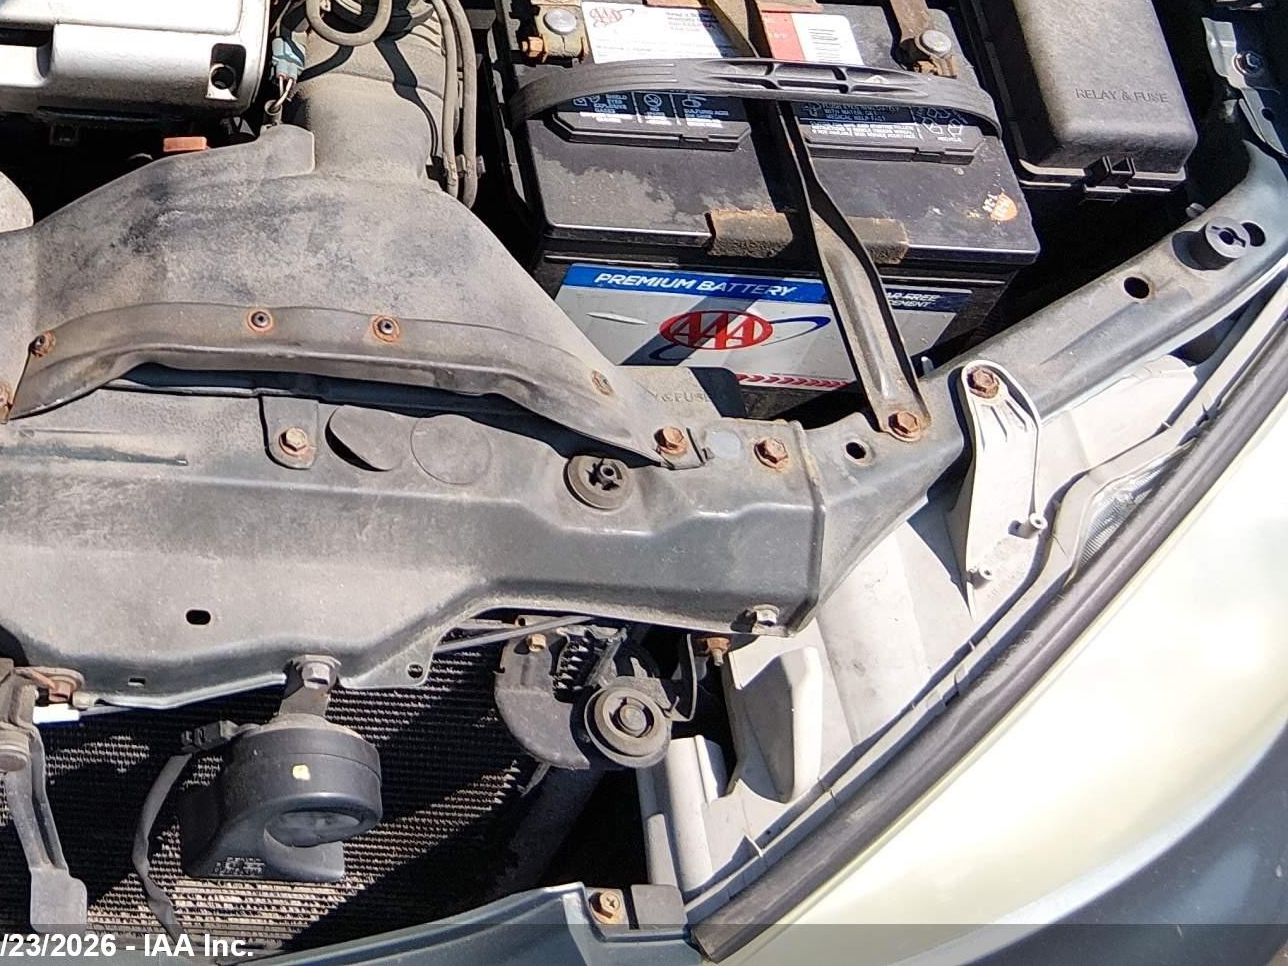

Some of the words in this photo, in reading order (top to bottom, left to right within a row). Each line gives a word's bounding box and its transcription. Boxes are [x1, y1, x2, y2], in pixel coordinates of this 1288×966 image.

[1074, 88, 1118, 101] RELAY
[1121, 90, 1132, 101] &
[1134, 91, 1169, 103] FUSE
[594, 273, 694, 290] PREMIUM
[696, 278, 798, 297] BATTERY
[668, 310, 758, 350] AAA
